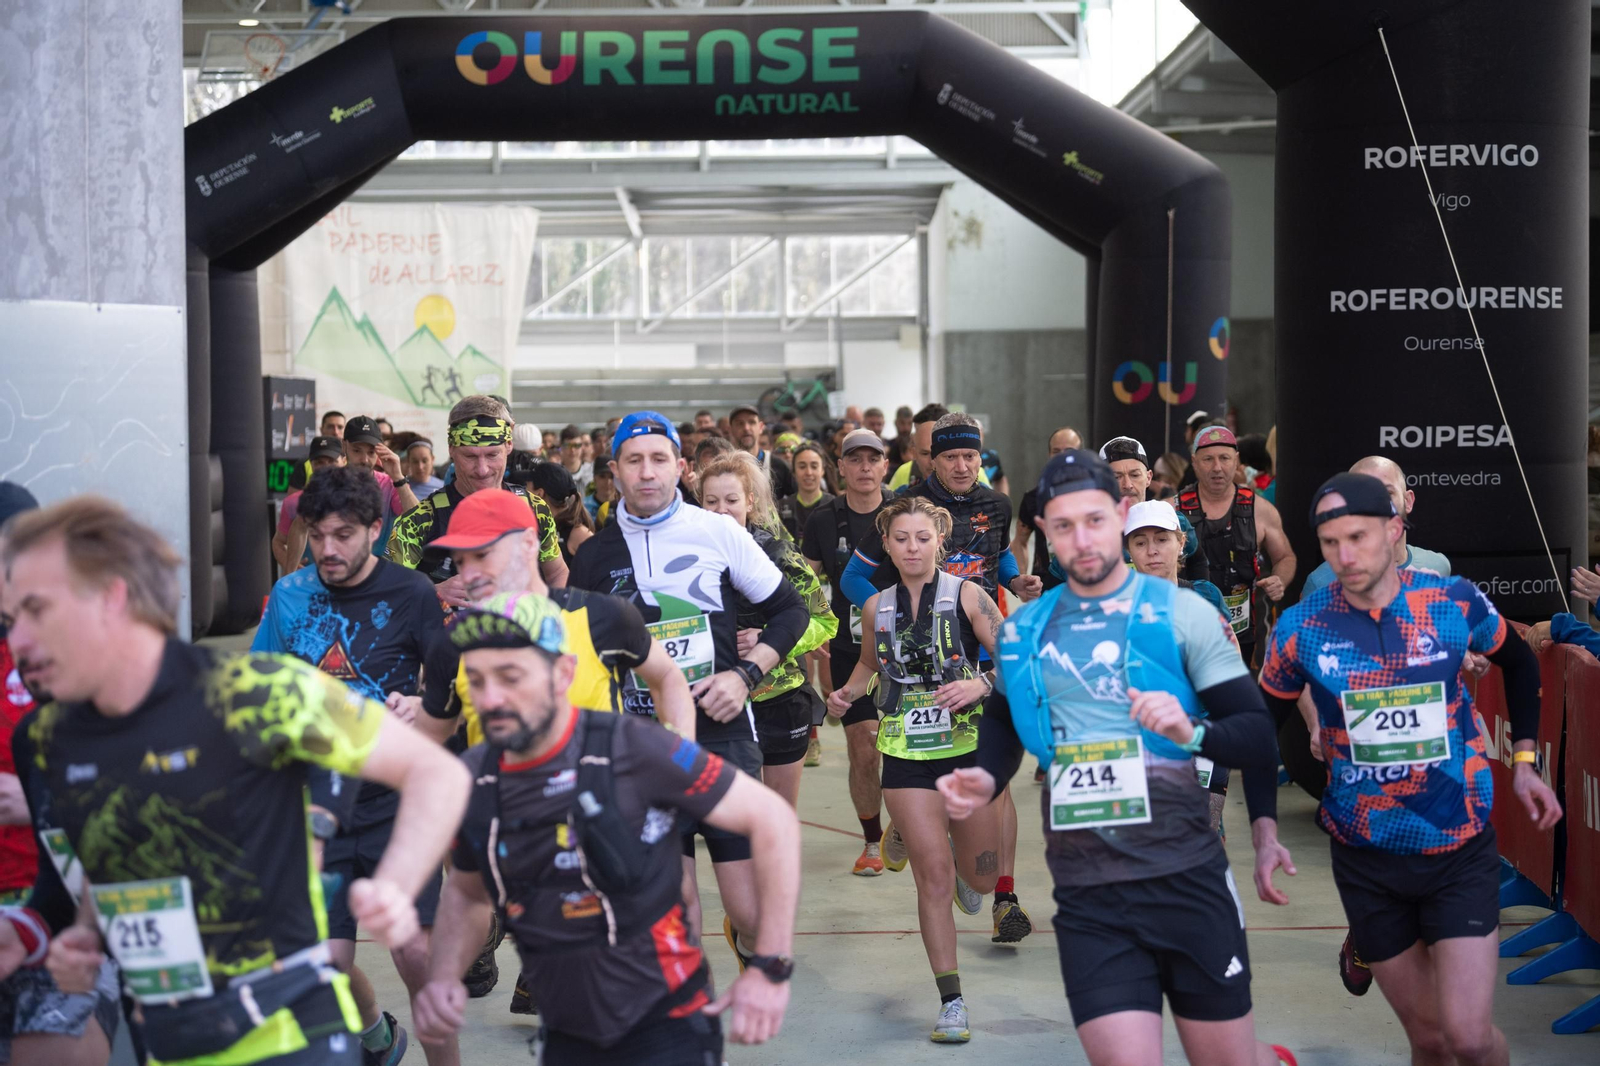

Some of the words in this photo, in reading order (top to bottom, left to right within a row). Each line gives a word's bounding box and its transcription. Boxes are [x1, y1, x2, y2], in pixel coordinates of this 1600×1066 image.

[455, 27, 860, 86] OURENSE
[715, 92, 860, 115] NATURAL
[1364, 144, 1539, 169] ROFERVIGO
[1428, 193, 1471, 211] Vigo
[315, 206, 361, 228] AIL
[329, 231, 442, 255] PADERNE
[369, 260, 391, 286] de
[396, 263, 505, 287] ALLARIZ
[1330, 287, 1563, 312] ROFEROURENSE
[1404, 336, 1485, 351] Ourense
[1112, 360, 1197, 405] OU
[1379, 425, 1514, 448] ROIPESA
[1405, 471, 1501, 486] ontevedra
[1472, 576, 1560, 595] ofer.com
[665, 639, 690, 658] 87
[911, 708, 942, 725] 217
[1375, 708, 1421, 731] 201
[1070, 765, 1116, 788] 214
[117, 918, 162, 948] 215
